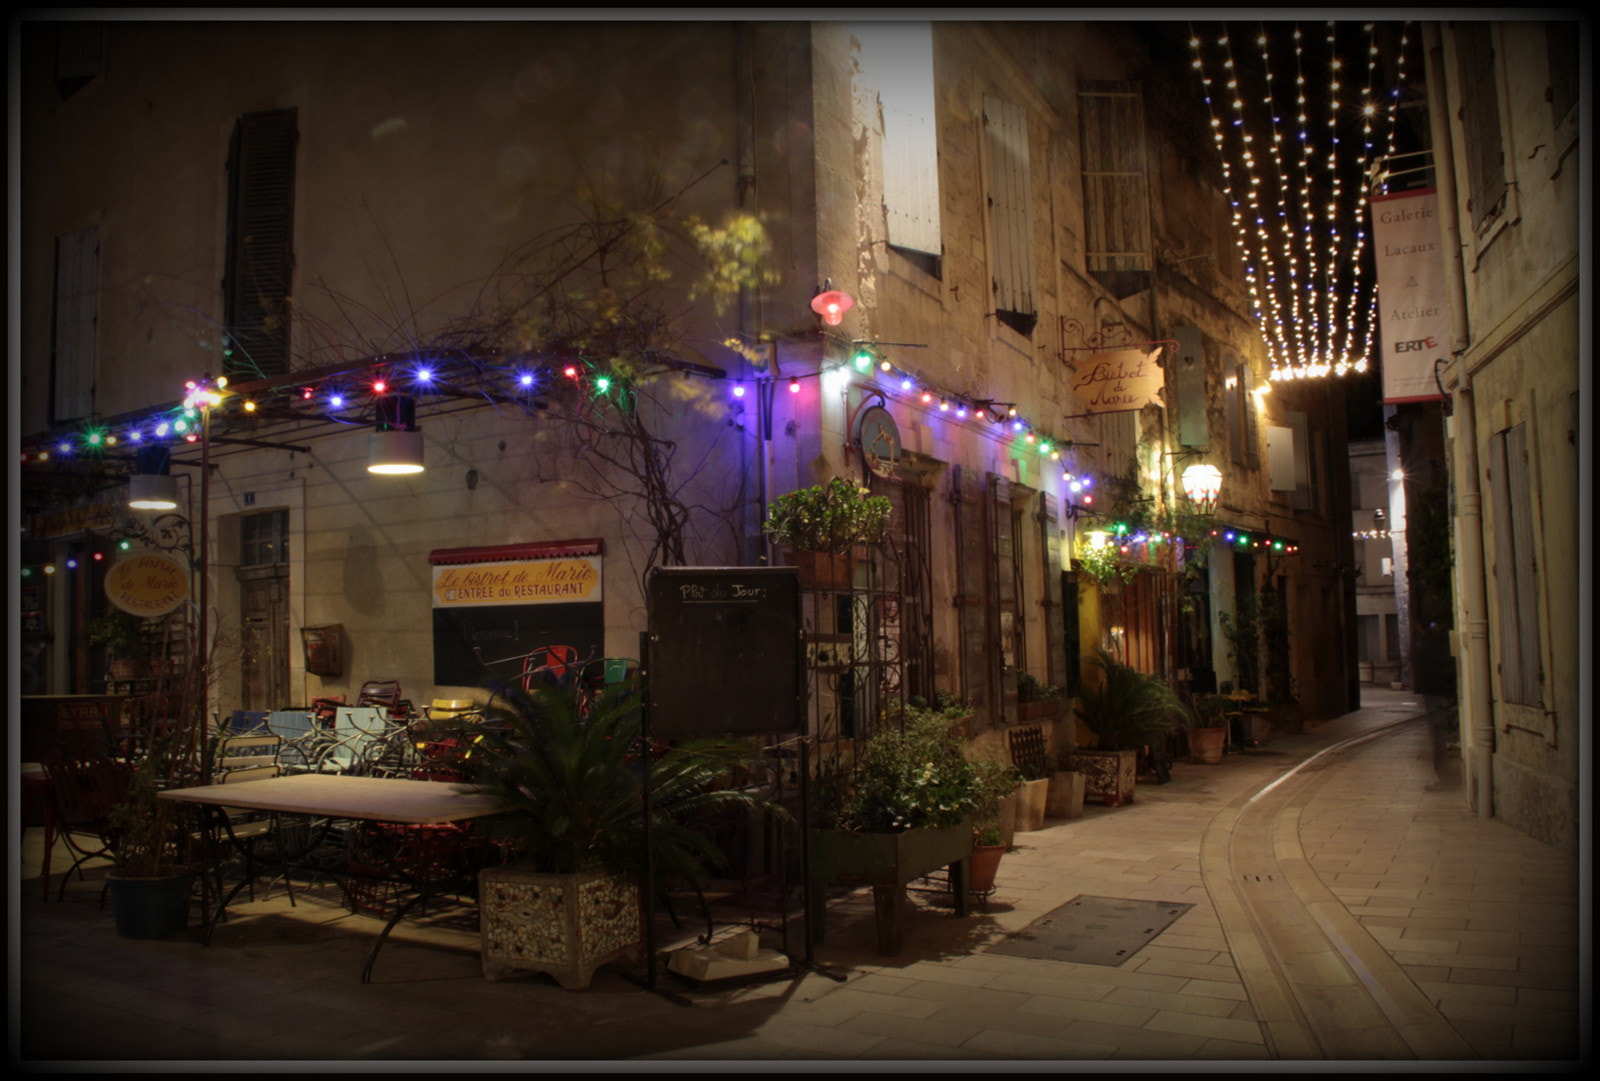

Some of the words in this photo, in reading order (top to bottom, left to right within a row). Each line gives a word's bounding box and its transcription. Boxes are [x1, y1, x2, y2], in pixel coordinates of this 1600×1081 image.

[1380, 207, 1433, 224] Galerie
[1385, 242, 1435, 257] Lacaux
[1390, 305, 1440, 321] Atelier
[439, 570, 460, 589] Le
[463, 569, 511, 587] bistrot
[513, 570, 530, 584] de
[546, 561, 593, 581] Marie
[499, 585, 511, 598] du
[514, 582, 584, 599] RESTAURANT
[679, 584, 707, 600] Plat
